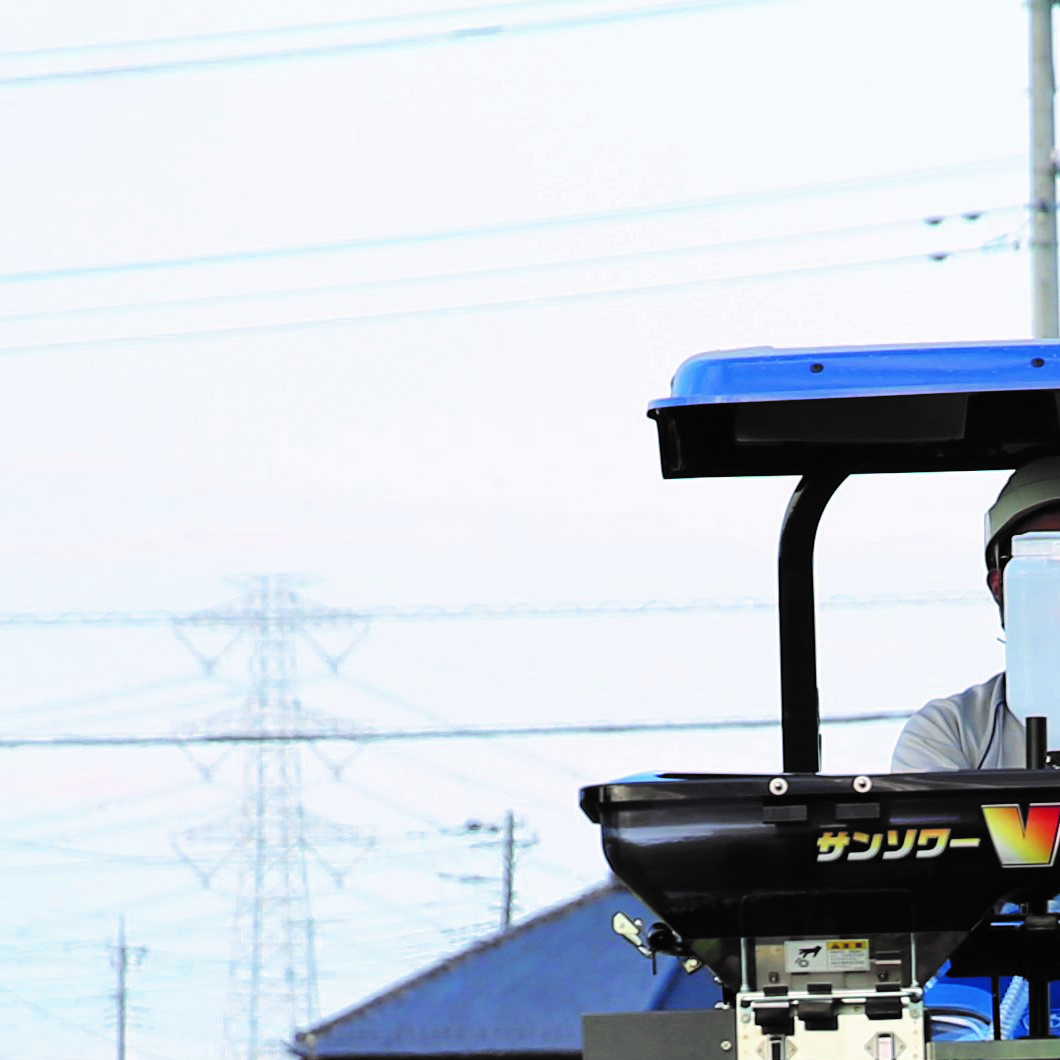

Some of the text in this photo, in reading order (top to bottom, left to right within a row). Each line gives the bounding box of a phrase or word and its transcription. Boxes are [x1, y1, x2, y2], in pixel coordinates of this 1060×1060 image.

[816, 829, 981, 862] サンソワー
